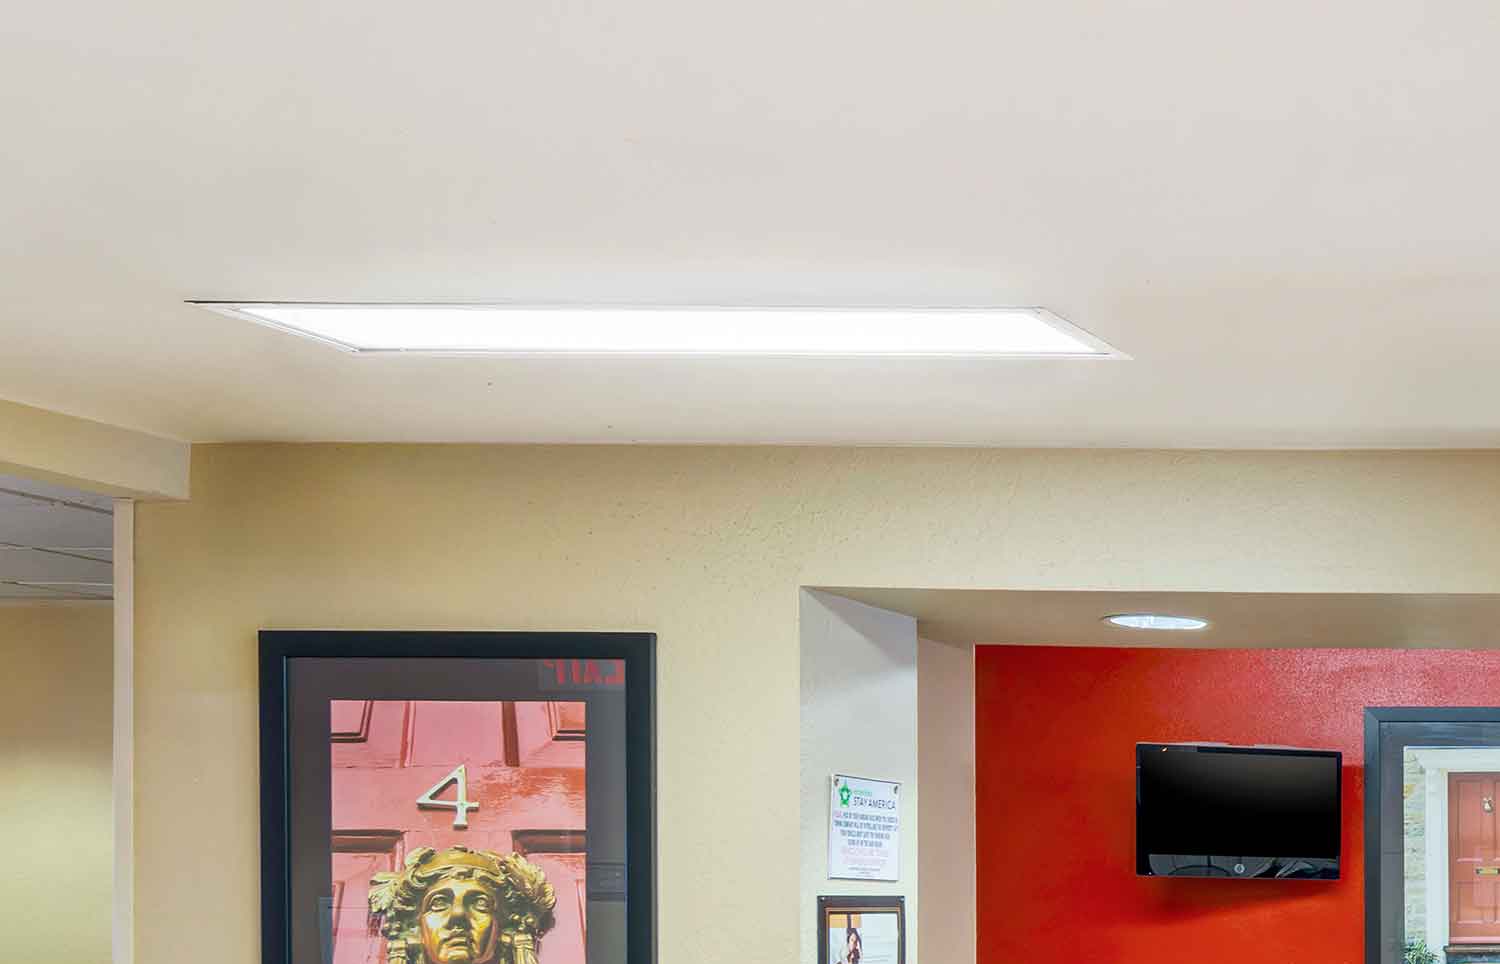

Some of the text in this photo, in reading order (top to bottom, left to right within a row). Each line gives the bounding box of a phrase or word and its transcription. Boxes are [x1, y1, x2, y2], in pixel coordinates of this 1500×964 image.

[416, 763, 480, 830] 4
[853, 796, 896, 810] STAY AMERICA
